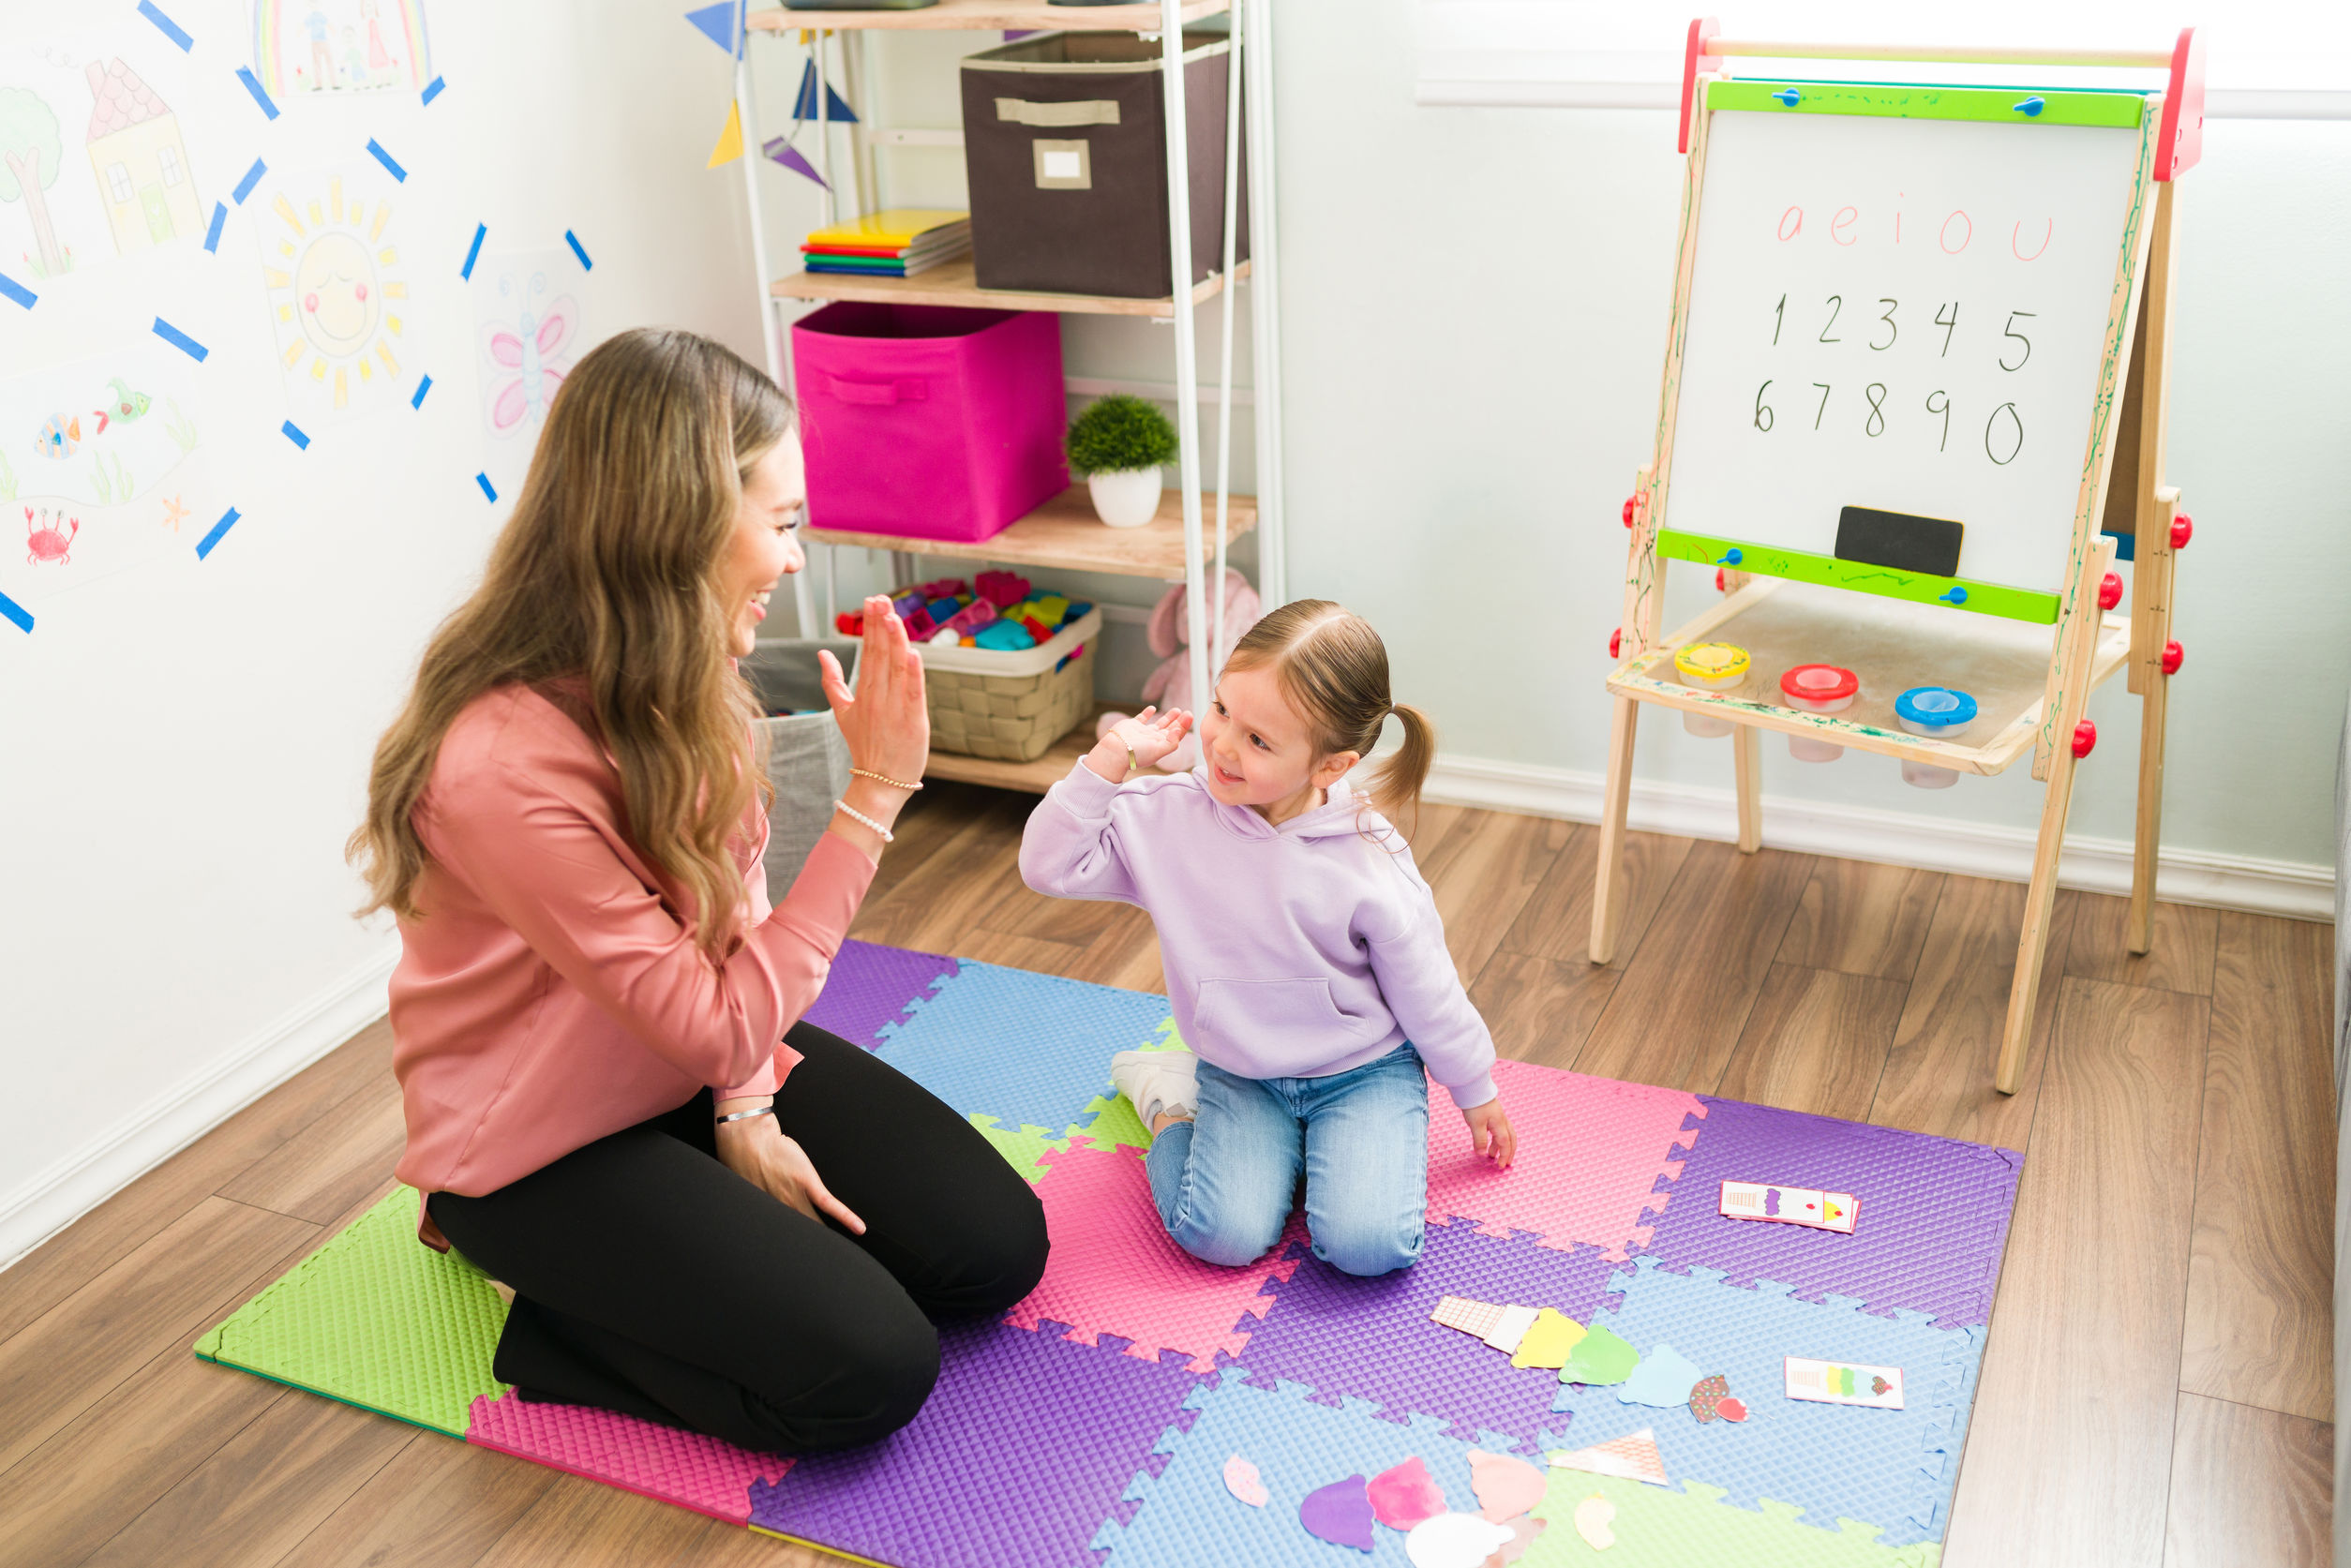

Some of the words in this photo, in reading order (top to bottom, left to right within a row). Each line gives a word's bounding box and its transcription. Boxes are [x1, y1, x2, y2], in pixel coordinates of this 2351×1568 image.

[1777, 205, 1804, 242] a
[1831, 205, 1859, 246] e
[1896, 191, 1905, 245] i
[1773, 291, 1788, 347] 1
[1818, 293, 1843, 344] 2
[1868, 297, 1898, 351] 3
[1933, 300, 1959, 359] 4
[1998, 309, 2038, 373] 5
[1753, 379, 1774, 434] 6
[1811, 381, 1831, 431] 7
[1864, 381, 1888, 439] 8
[1925, 389, 1951, 454] 9
[1984, 401, 2024, 466] 0
